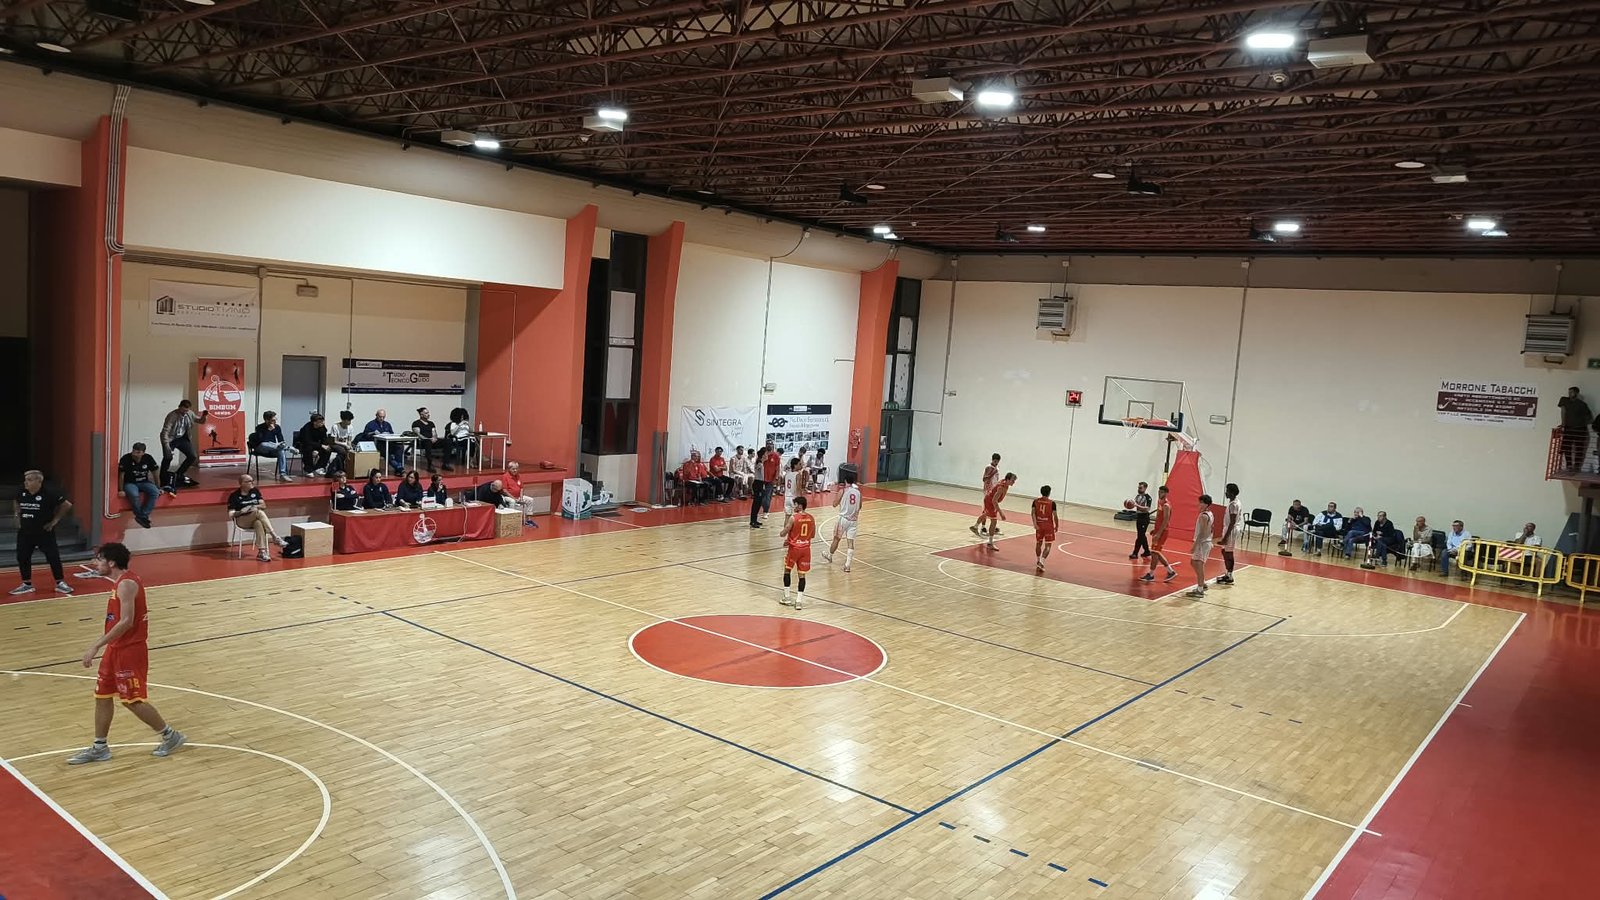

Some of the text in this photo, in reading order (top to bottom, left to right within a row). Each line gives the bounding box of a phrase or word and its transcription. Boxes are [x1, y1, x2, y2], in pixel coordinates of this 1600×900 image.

[1441, 381, 1536, 395] MORRONE TABACCHI
[1069, 392, 1080, 401] 24
[706, 418, 742, 427] SINTEGRA
[786, 480, 792, 489] 6
[849, 493, 856, 505] 8
[1039, 504, 1046, 515] 4
[801, 523, 808, 537] 0
